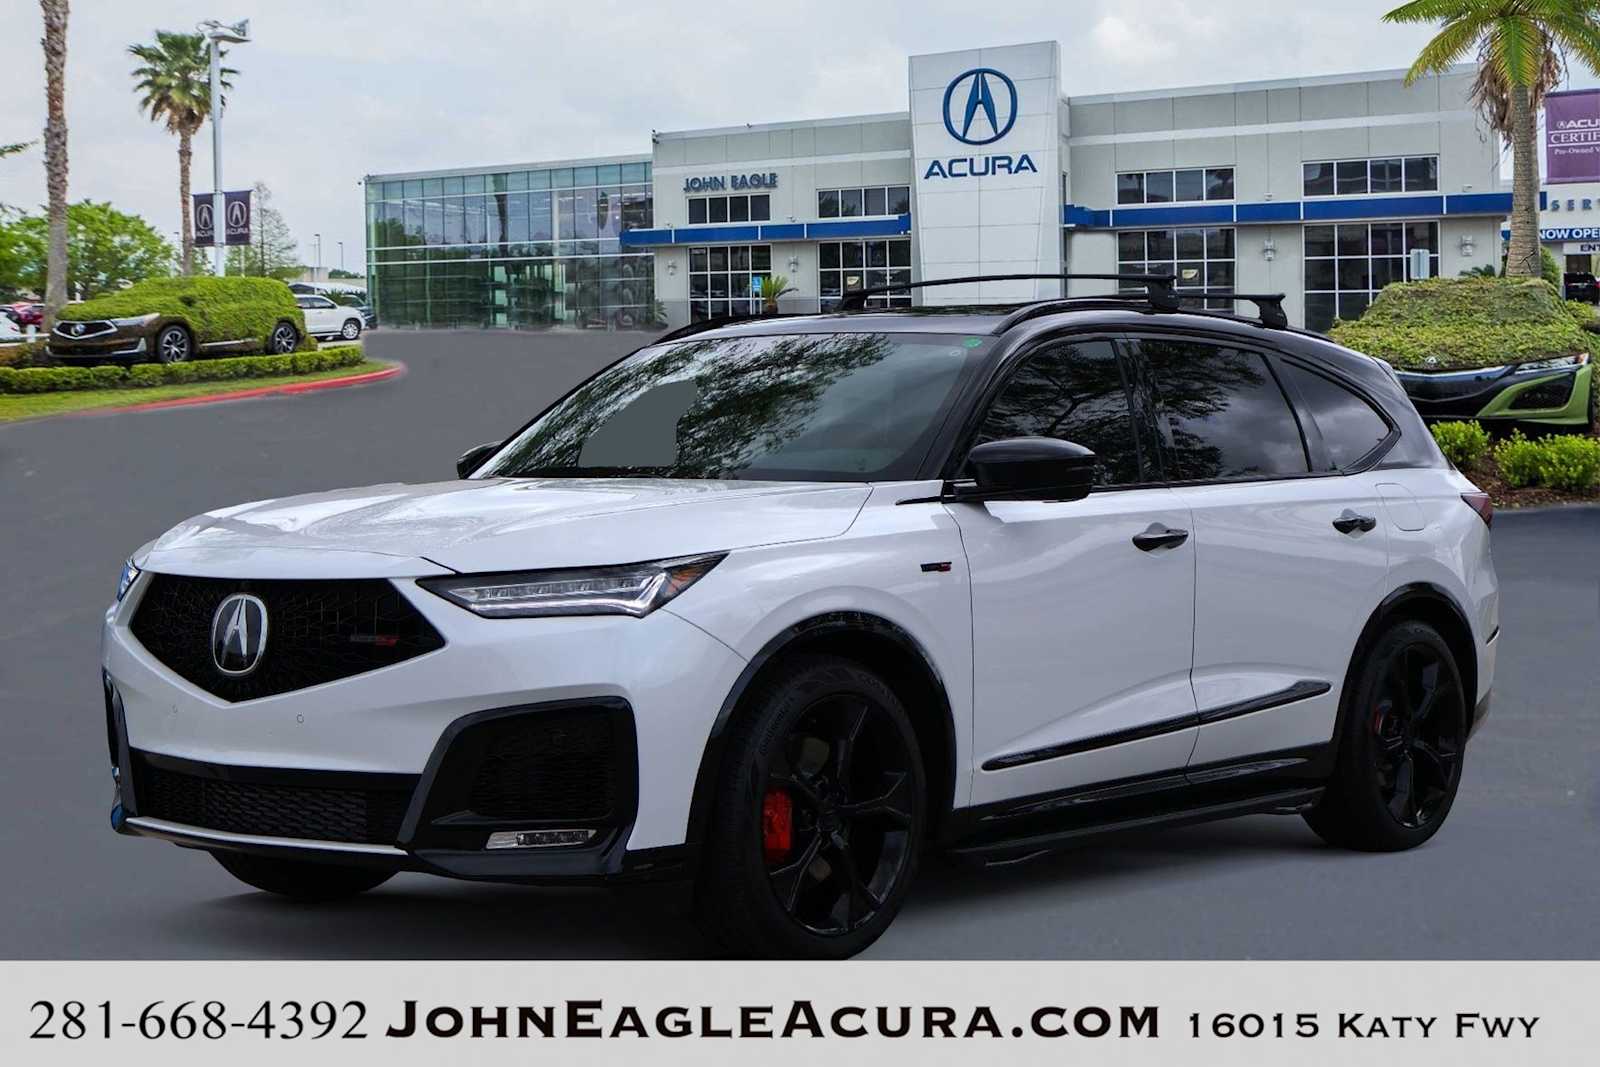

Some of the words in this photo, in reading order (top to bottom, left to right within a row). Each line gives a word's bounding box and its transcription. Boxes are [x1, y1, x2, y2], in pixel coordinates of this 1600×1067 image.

[1566, 119, 1600, 129] ACU
[924, 154, 1038, 180] ACURA
[683, 176, 725, 192] JOHN
[731, 173, 777, 190] EAGLE
[1551, 198, 1600, 211] SER
[1572, 228, 1600, 239] OPE
